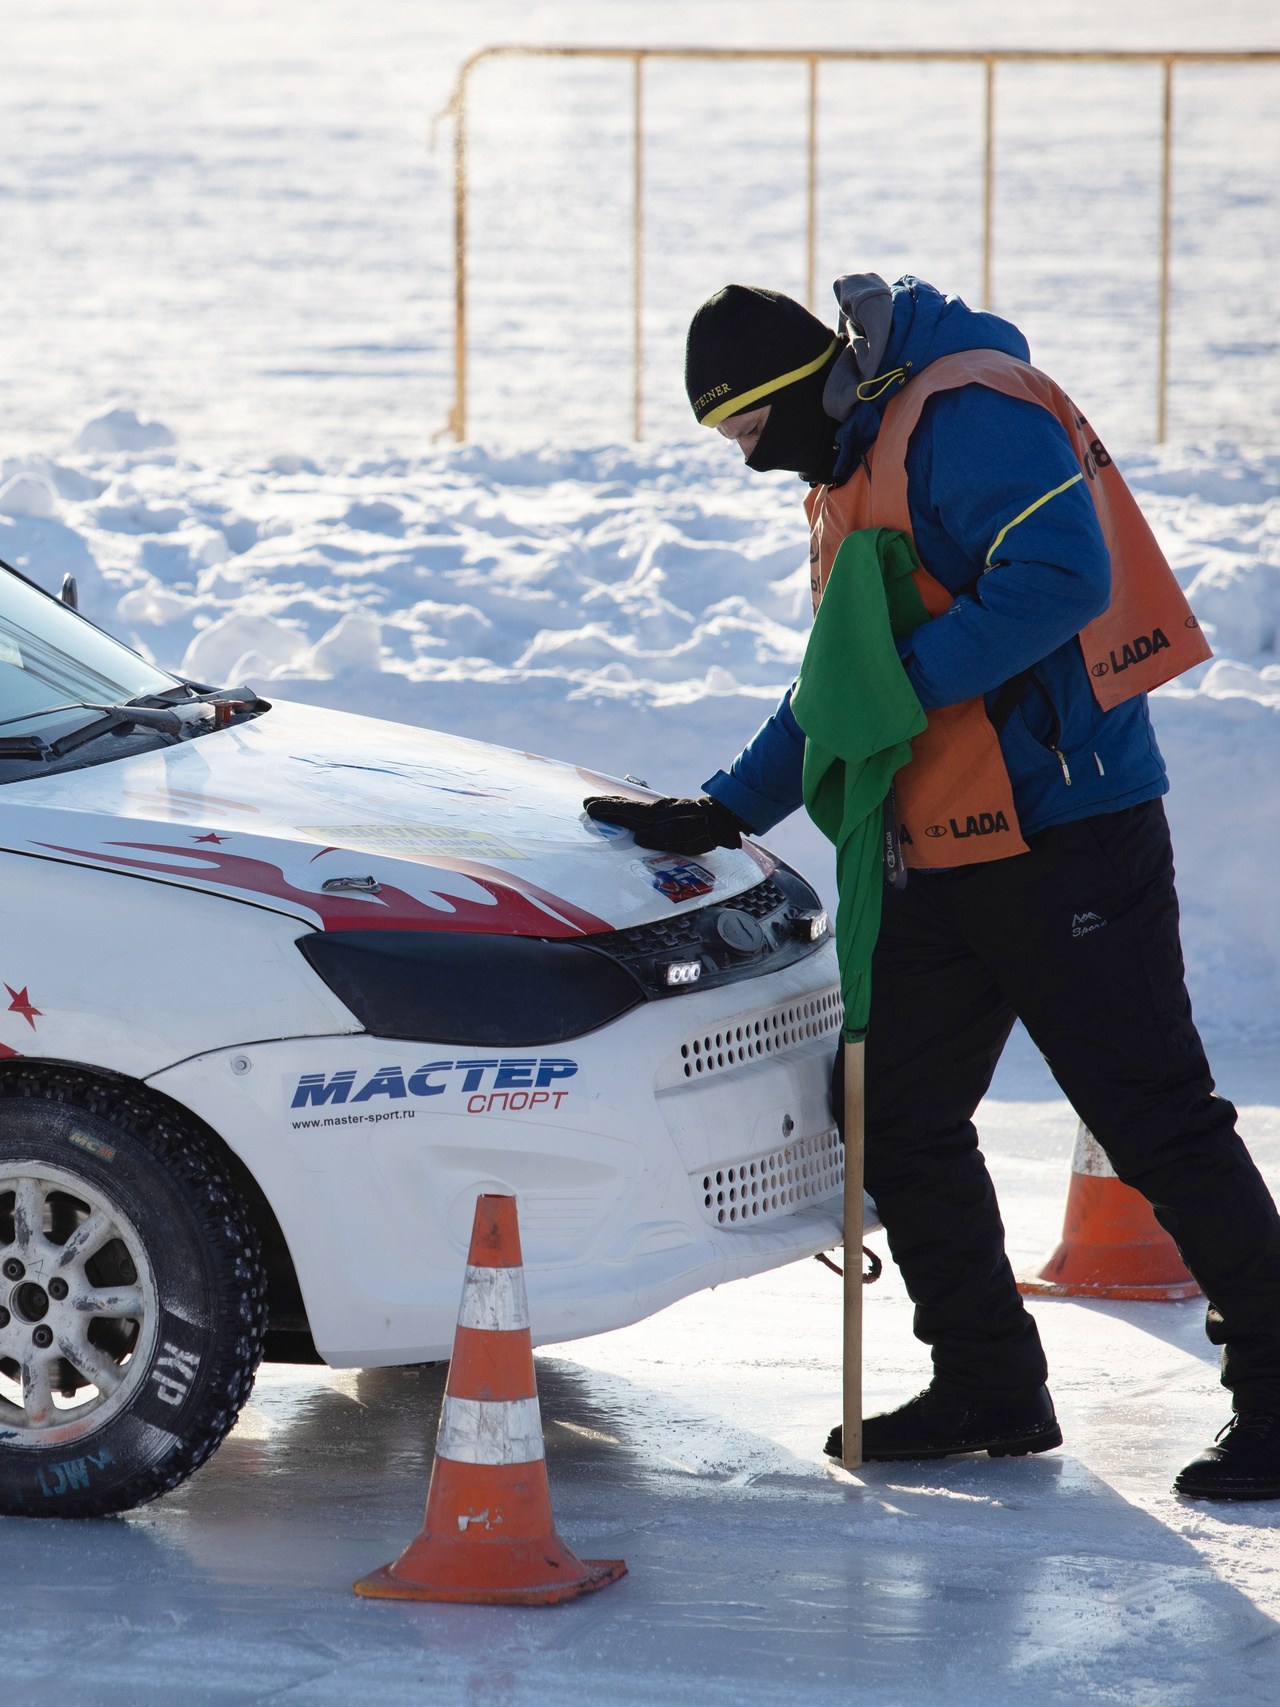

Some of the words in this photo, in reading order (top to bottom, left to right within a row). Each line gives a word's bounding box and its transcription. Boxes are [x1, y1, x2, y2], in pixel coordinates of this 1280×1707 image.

[1109, 627, 1171, 674] LADA
[949, 810, 1010, 839] LADA
[290, 1057, 579, 1109] МАСТЕР
[466, 1090, 569, 1114] СПОРТ
[291, 1109, 416, 1131] www.master-sport.ru
